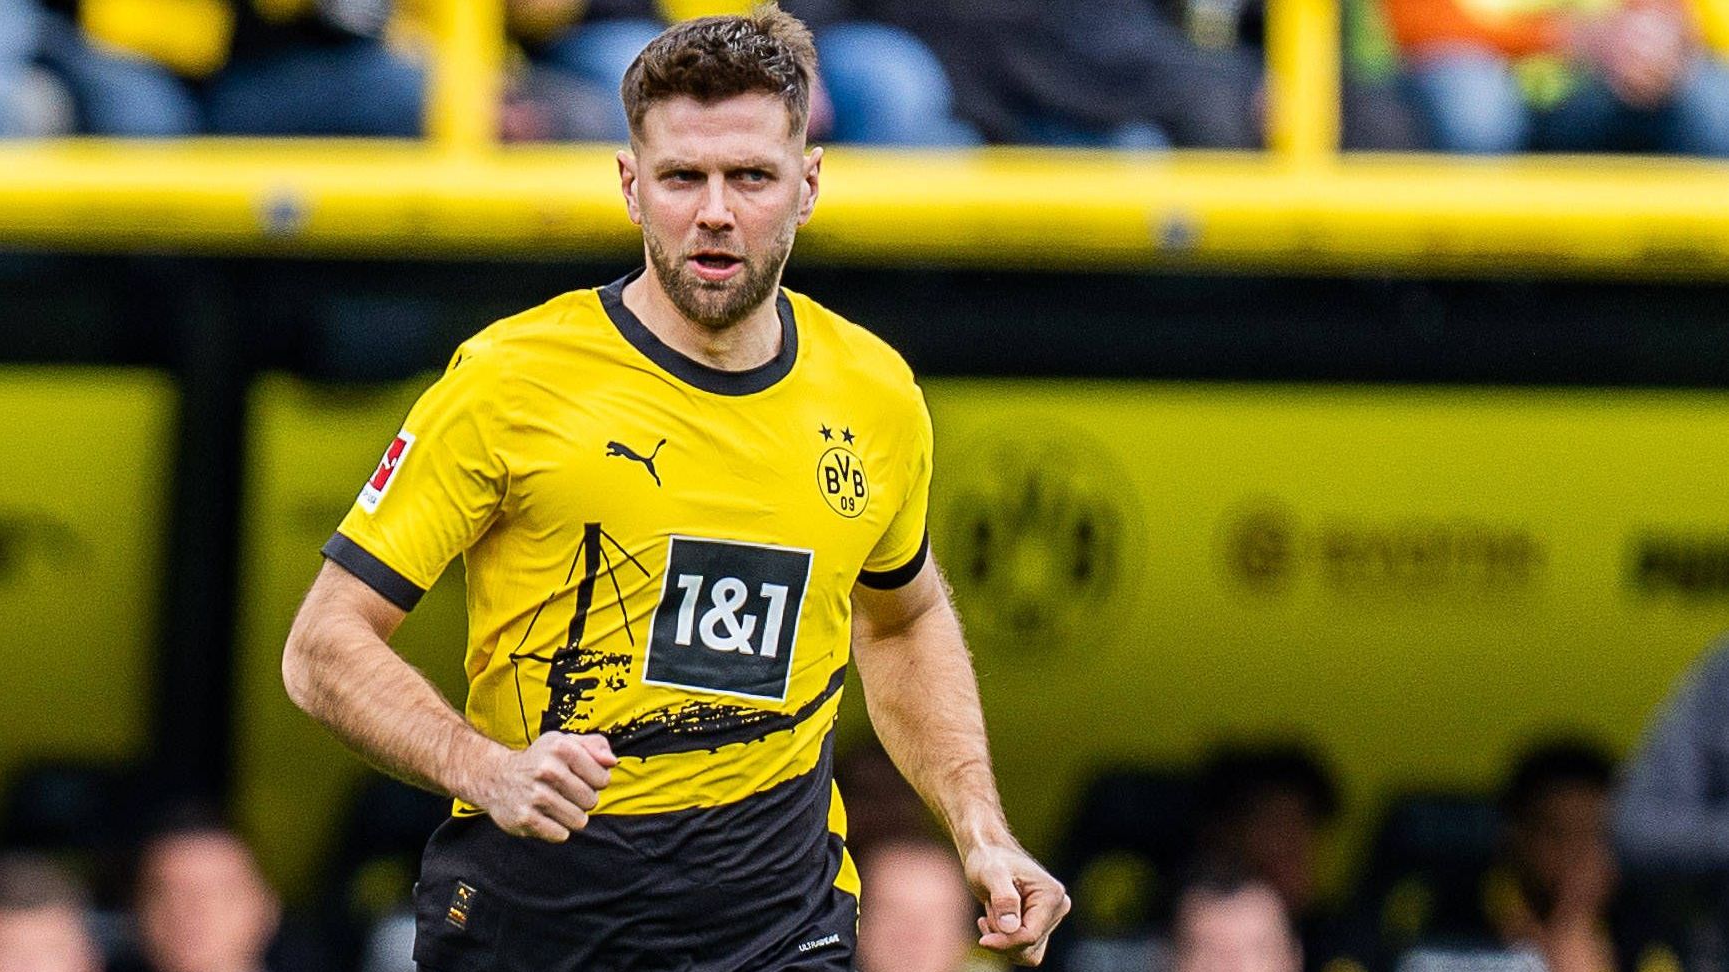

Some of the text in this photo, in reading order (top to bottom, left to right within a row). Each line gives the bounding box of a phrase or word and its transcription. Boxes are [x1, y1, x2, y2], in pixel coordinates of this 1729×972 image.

[824, 453, 865, 498] BVB
[840, 496, 855, 512] 09
[675, 573, 789, 659] 1&1
